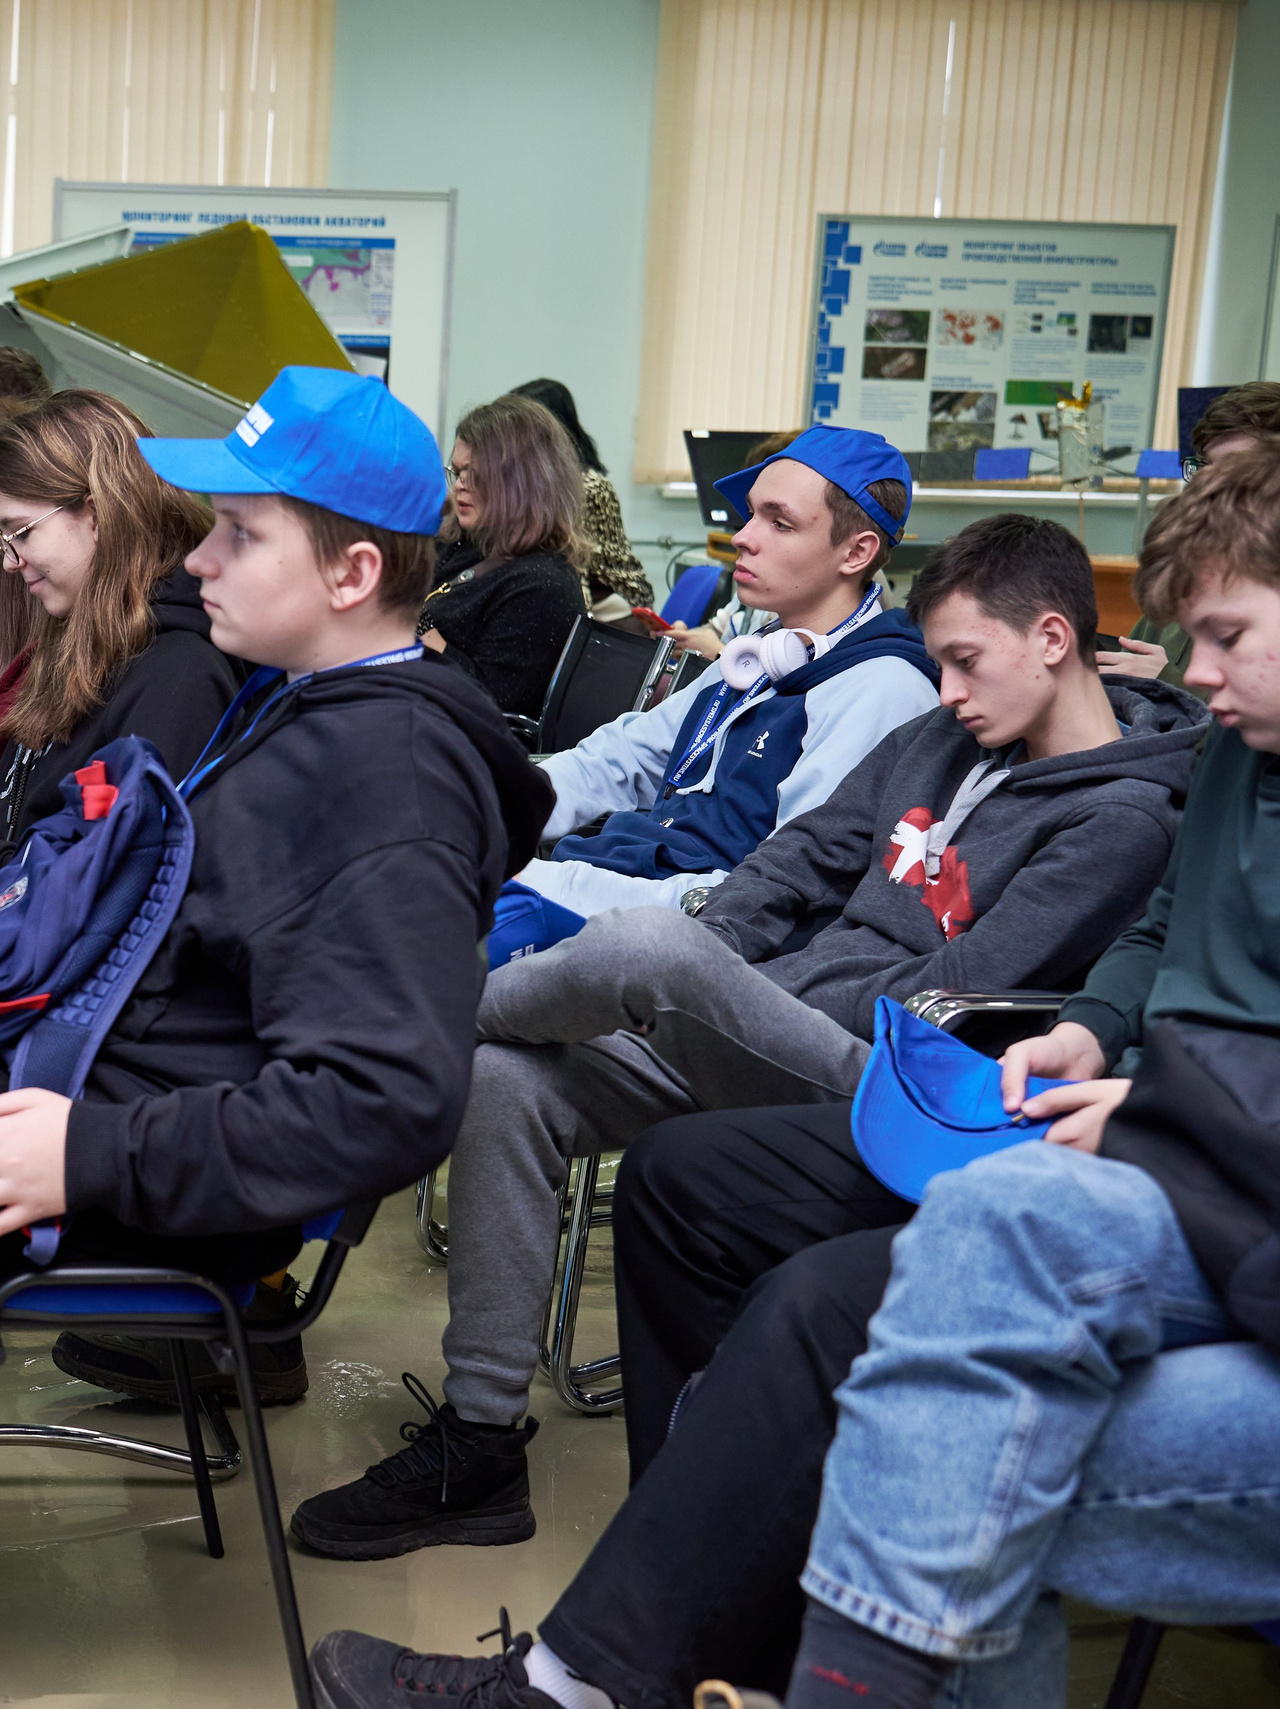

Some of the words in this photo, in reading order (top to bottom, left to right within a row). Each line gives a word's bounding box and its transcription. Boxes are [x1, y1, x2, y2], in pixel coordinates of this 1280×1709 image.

[122, 211, 193, 224] МОНИТОРИНГ
[252, 214, 320, 227] ОБСТАНОВКИ
[324, 215, 386, 228] АКВАТОРИЙ
[741, 659, 751, 669] R
